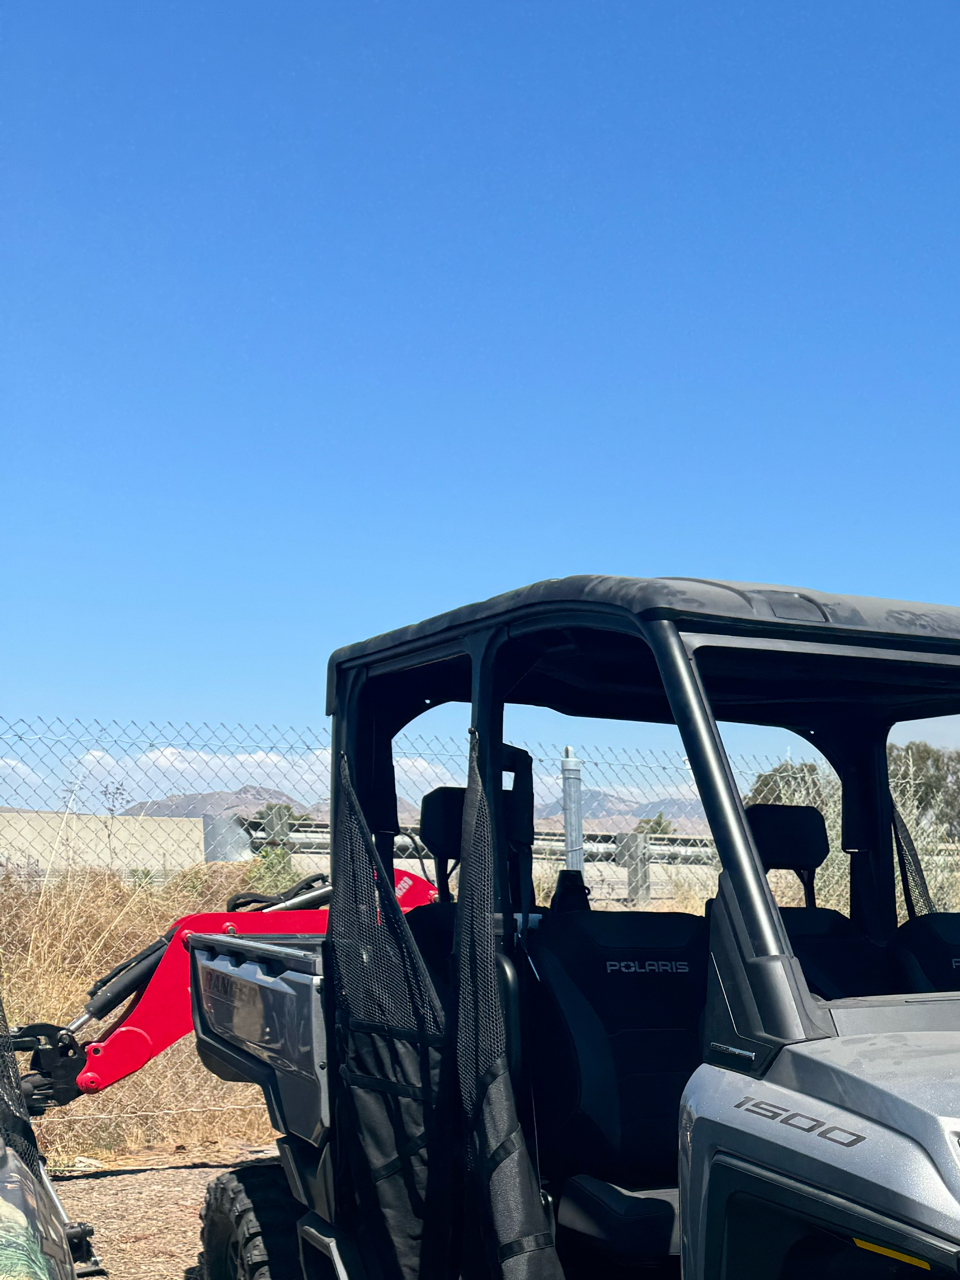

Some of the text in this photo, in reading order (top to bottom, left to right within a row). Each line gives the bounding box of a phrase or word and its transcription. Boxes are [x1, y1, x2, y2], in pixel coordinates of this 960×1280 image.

[606, 961, 689, 973] POLARIS
[205, 969, 258, 1007] RANGER
[733, 1096, 867, 1148] 1500
